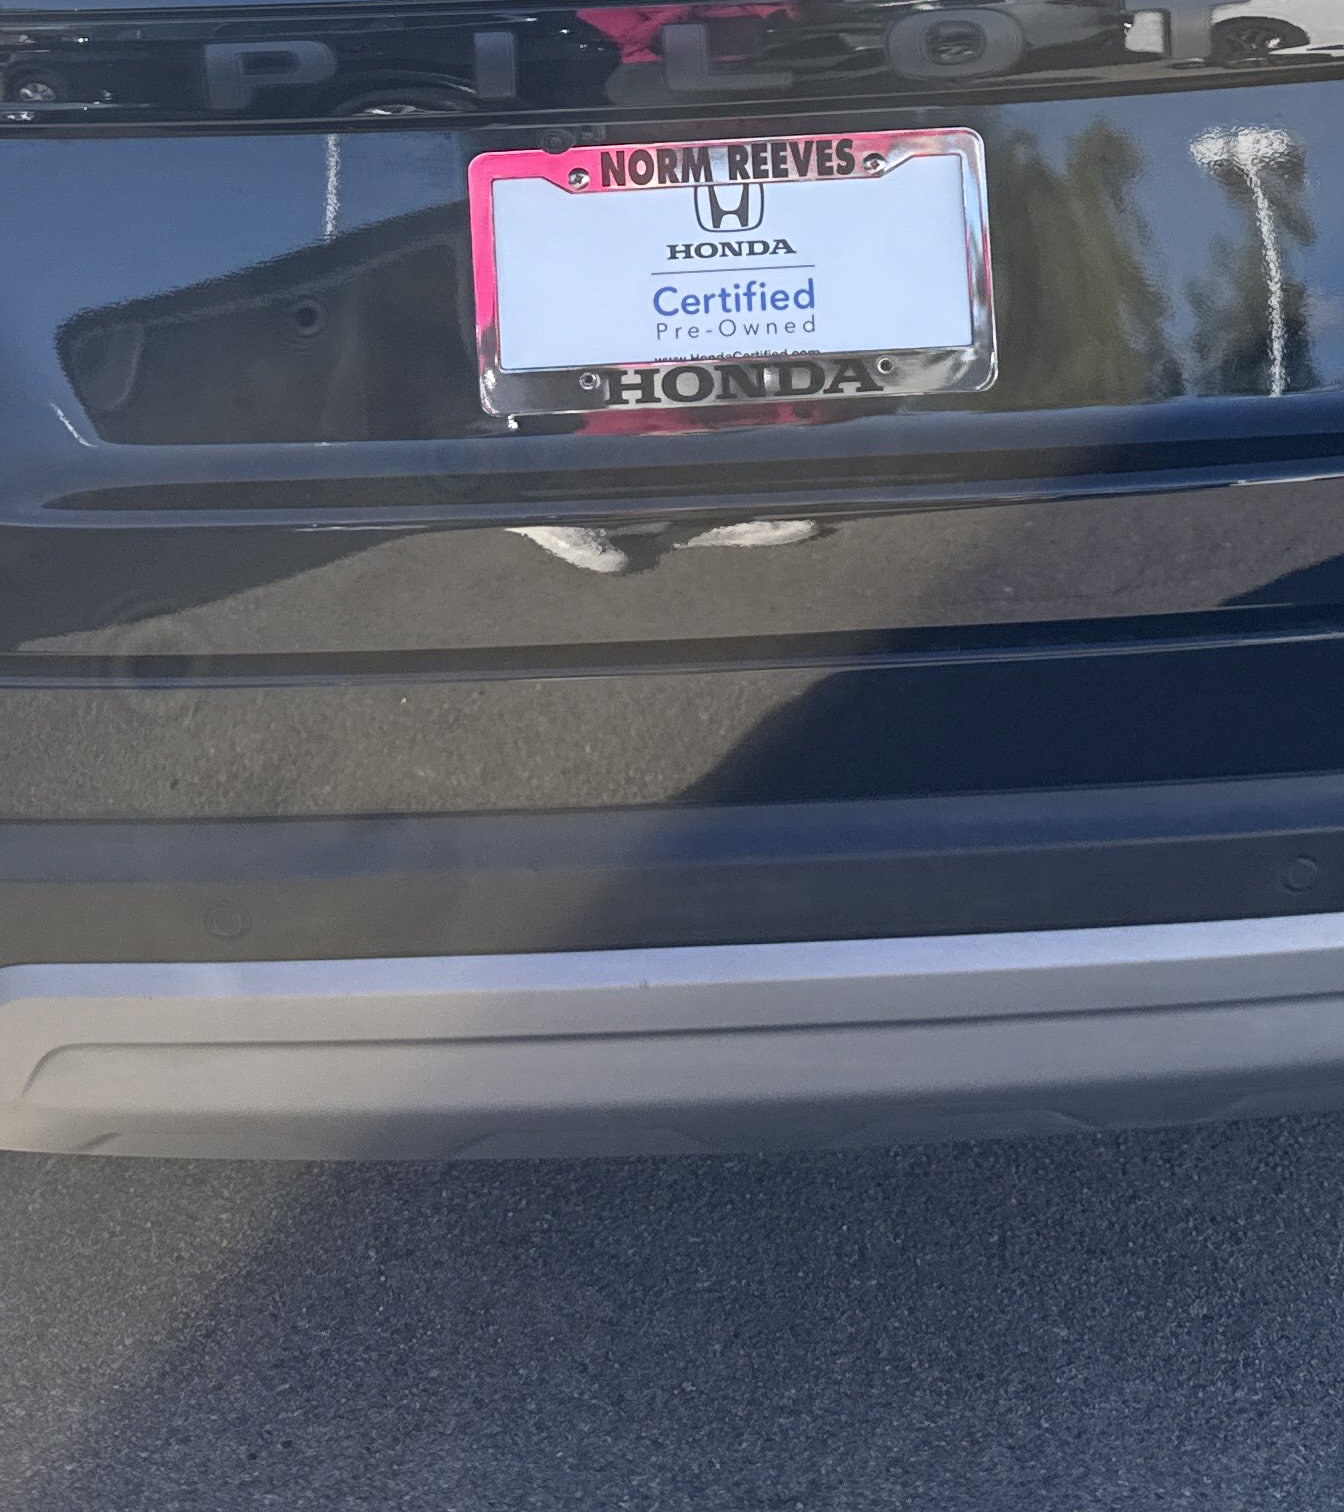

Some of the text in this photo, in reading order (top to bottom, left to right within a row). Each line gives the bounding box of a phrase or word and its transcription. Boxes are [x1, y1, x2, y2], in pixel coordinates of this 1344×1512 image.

[600, 138, 856, 187] NORM REEVES
[666, 238, 797, 260] HONDA
[653, 277, 815, 316] Certified
[656, 314, 816, 340] Pre-Owned
[654, 349, 821, 363] wwwHondaCertifiedcom
[606, 358, 885, 405] HONDA
